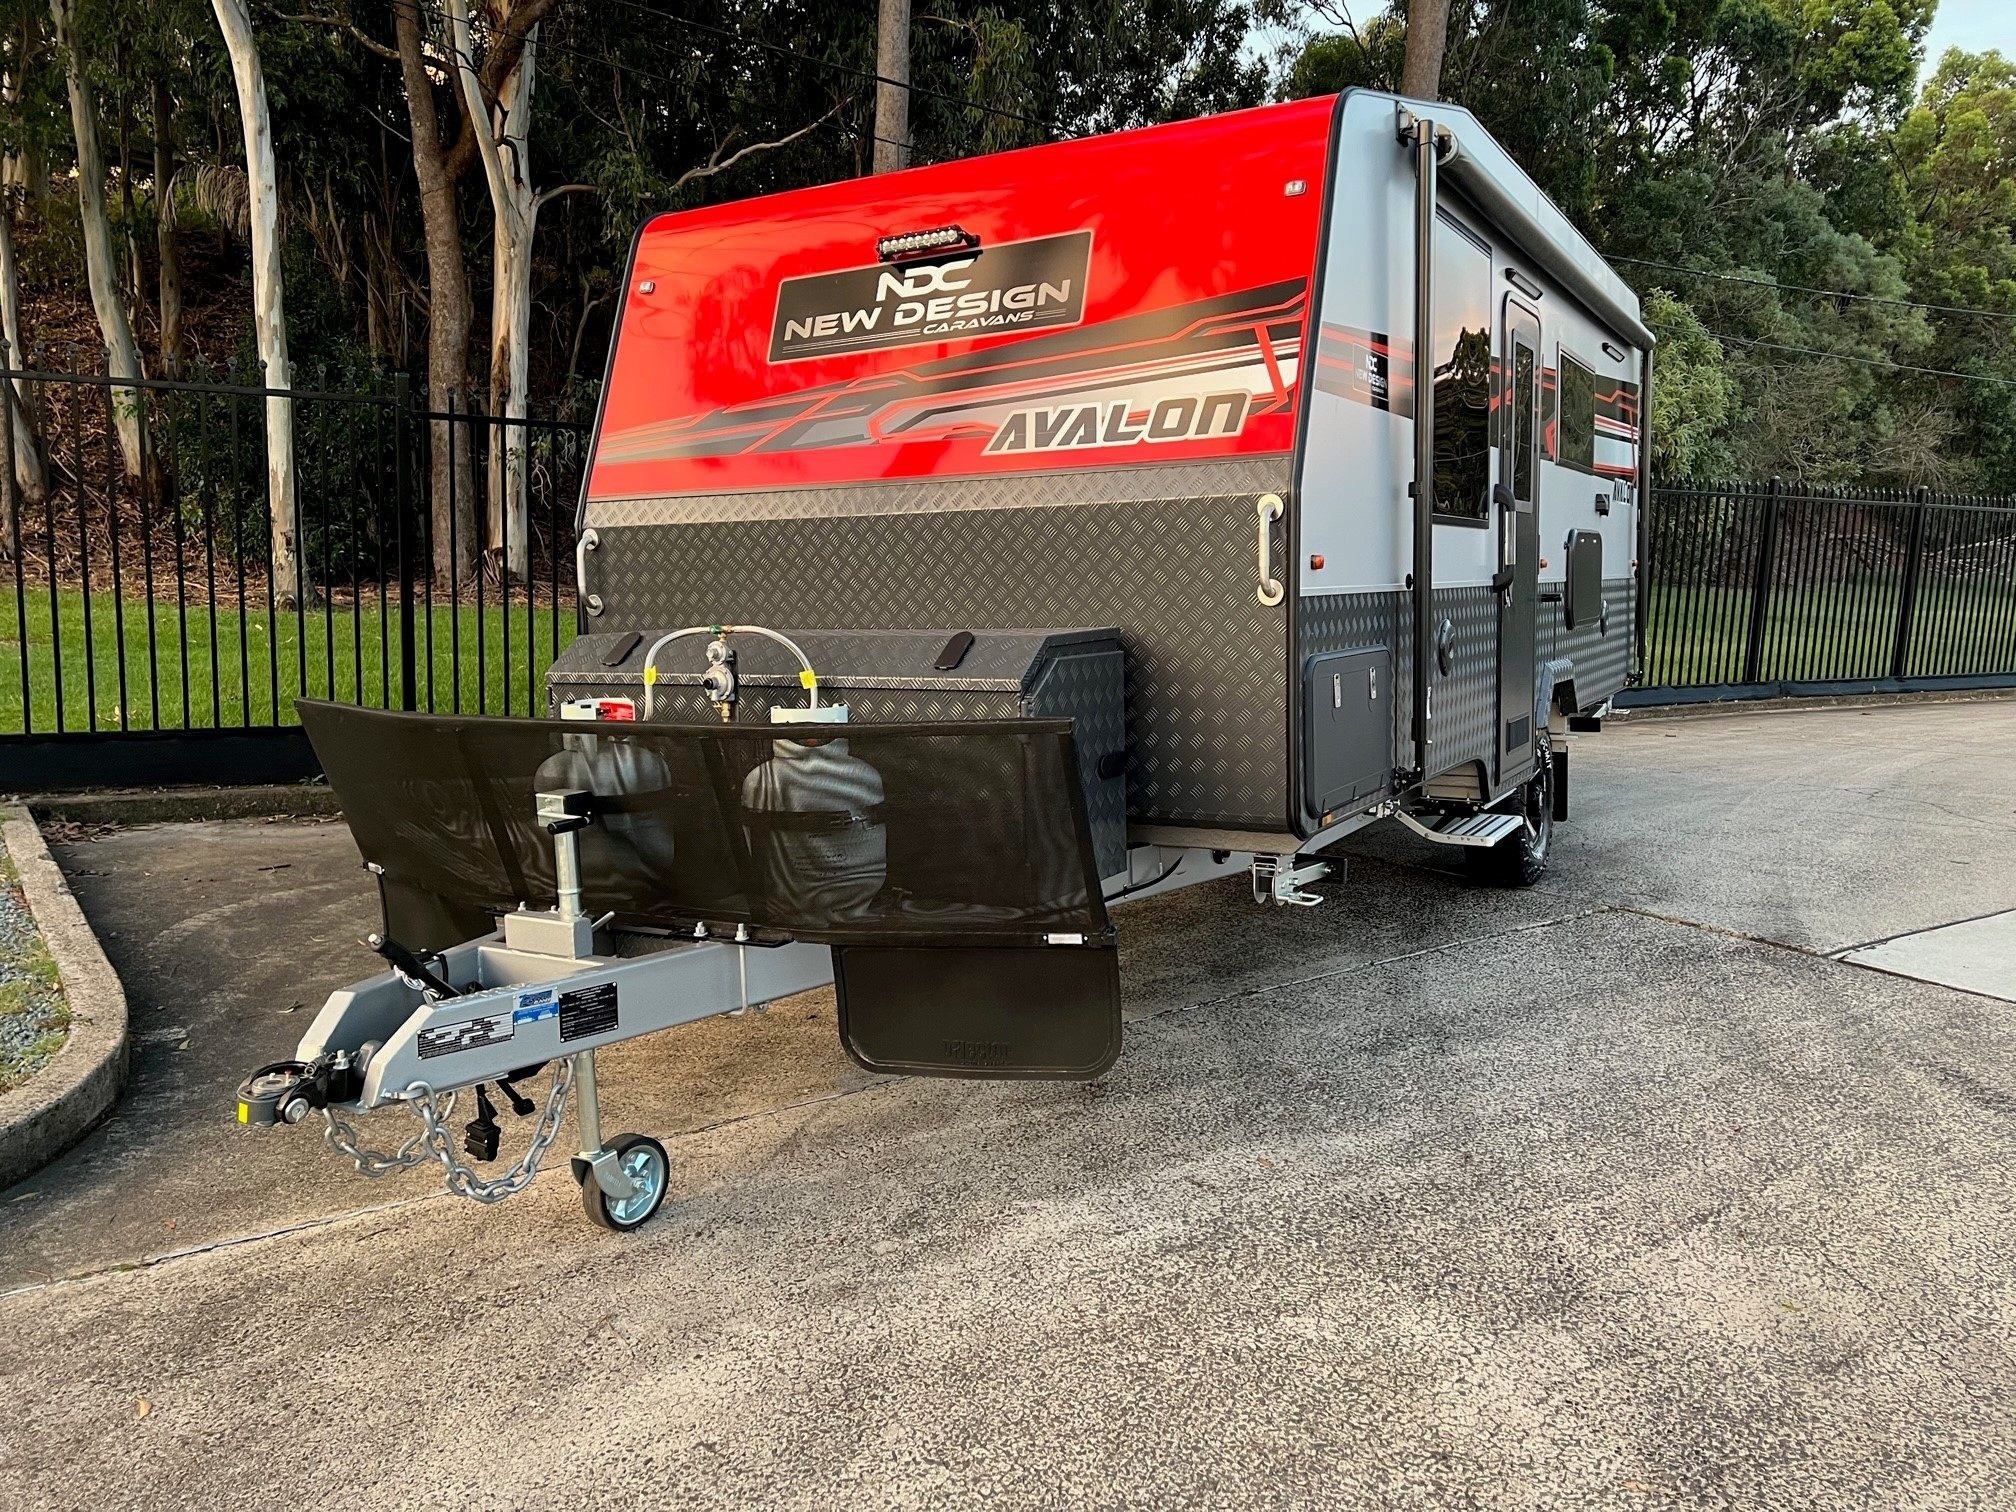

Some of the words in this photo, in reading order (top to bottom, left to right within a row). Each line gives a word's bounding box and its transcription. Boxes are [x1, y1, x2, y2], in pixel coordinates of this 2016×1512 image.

[876, 259, 975, 302] NDC
[784, 306, 882, 341] NEW
[893, 279, 1071, 326] DESIGN
[922, 310, 1035, 336] CARAVANS
[984, 390, 1250, 454] AVALON
